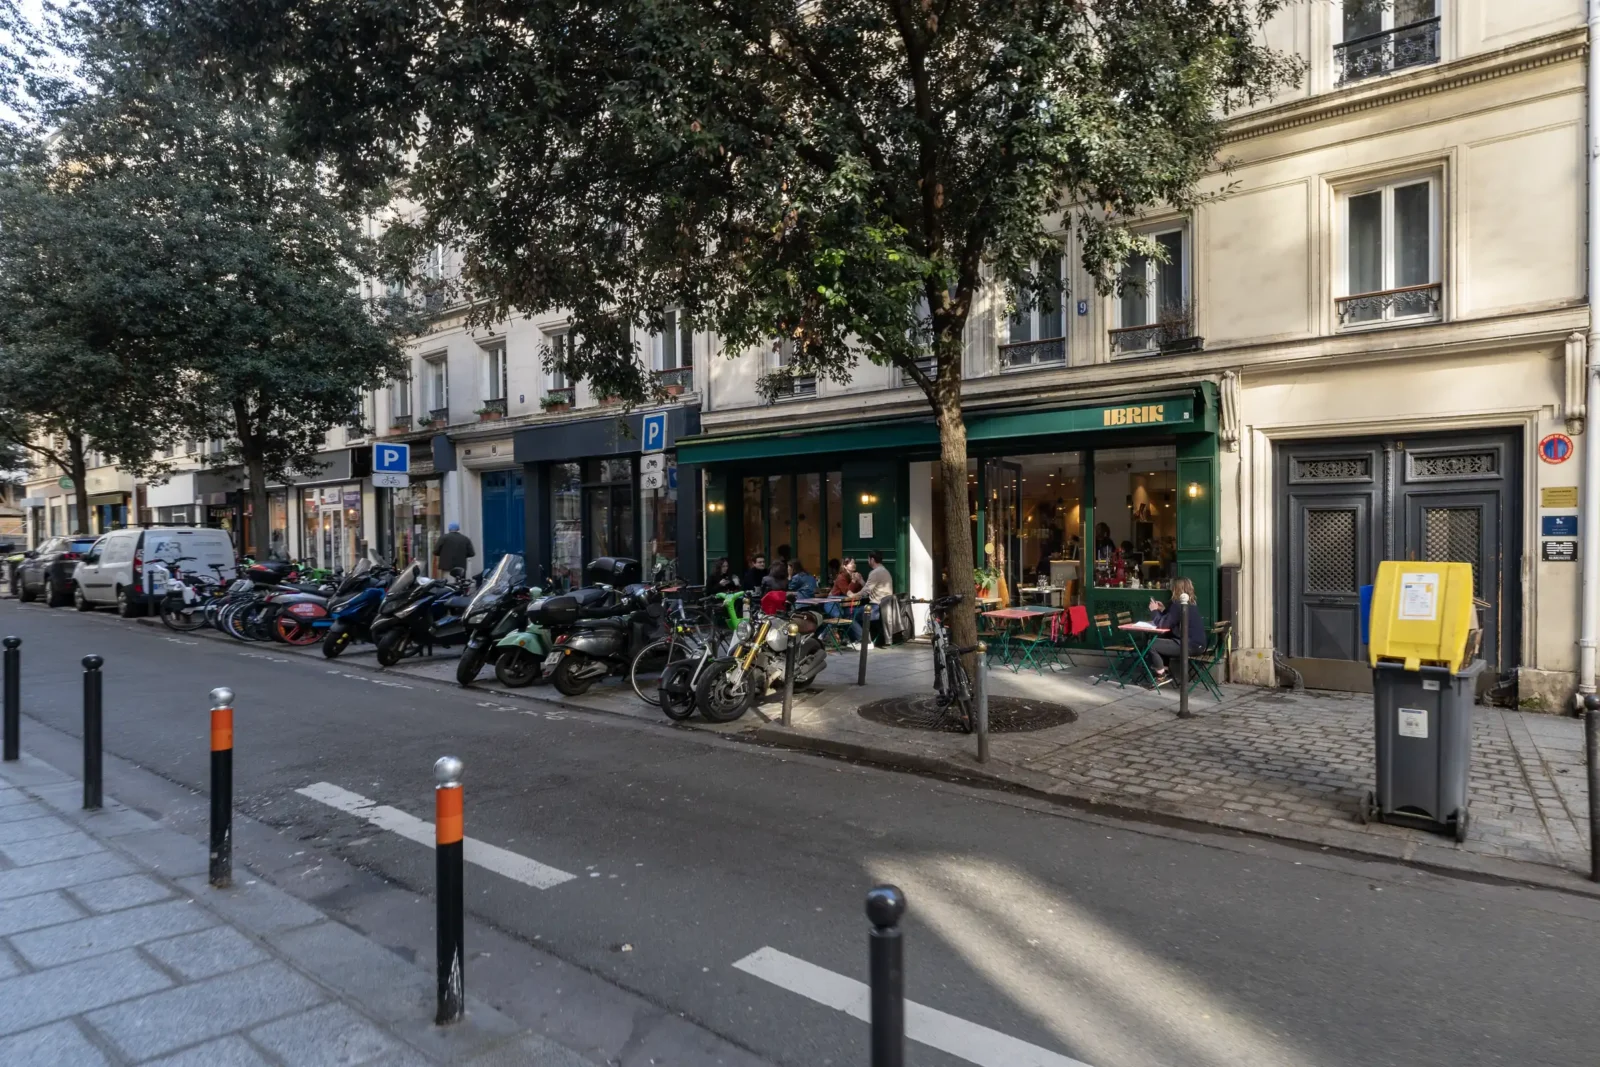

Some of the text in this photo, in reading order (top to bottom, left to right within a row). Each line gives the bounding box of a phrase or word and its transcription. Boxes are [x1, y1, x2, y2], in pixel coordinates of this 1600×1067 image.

[1079, 302, 1087, 313] 9
[1103, 404, 1164, 426] IBRIK
[648, 422, 659, 445] P
[383, 449, 399, 467] P
